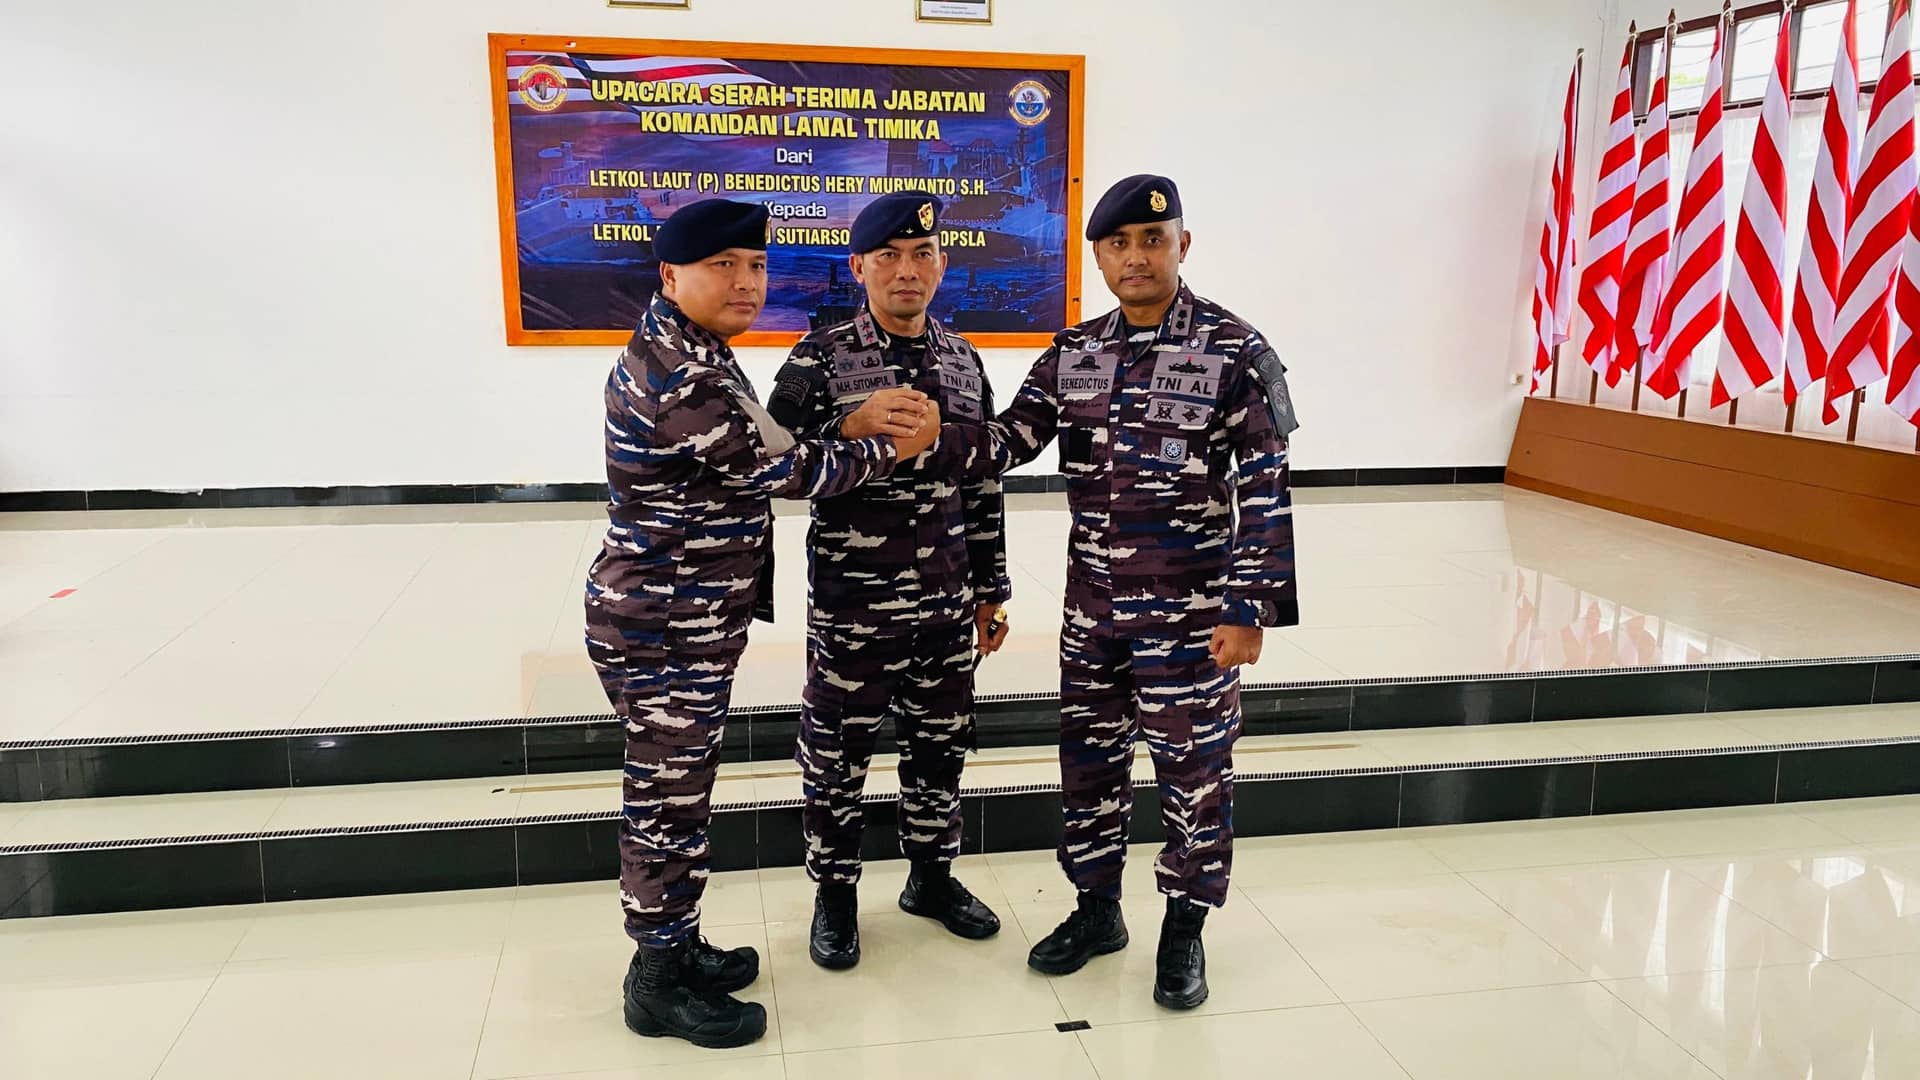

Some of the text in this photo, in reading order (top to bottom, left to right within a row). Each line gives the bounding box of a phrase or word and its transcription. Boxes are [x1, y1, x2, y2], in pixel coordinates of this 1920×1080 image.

[591, 79, 703, 104] UPACARA
[709, 84, 786, 107] SERAH
[792, 86, 877, 110] TERIMA
[883, 89, 986, 113] JABATAN
[641, 111, 941, 140] KOMANDAN LANAL TIMIKA
[776, 148, 813, 164] Dari
[590, 169, 989, 195] LETKOL LAUT (P) BENEDICTUS HERY MURWANTO S.H.
[593, 223, 652, 241] LETKOL
[776, 227, 850, 245] SUTIARSO
[836, 375, 892, 393] M.H. SITOMPUL
[943, 373, 978, 392] TNI AL
[1060, 377, 1109, 390] BENEDICTUS
[1156, 376, 1212, 395] TNI AL
